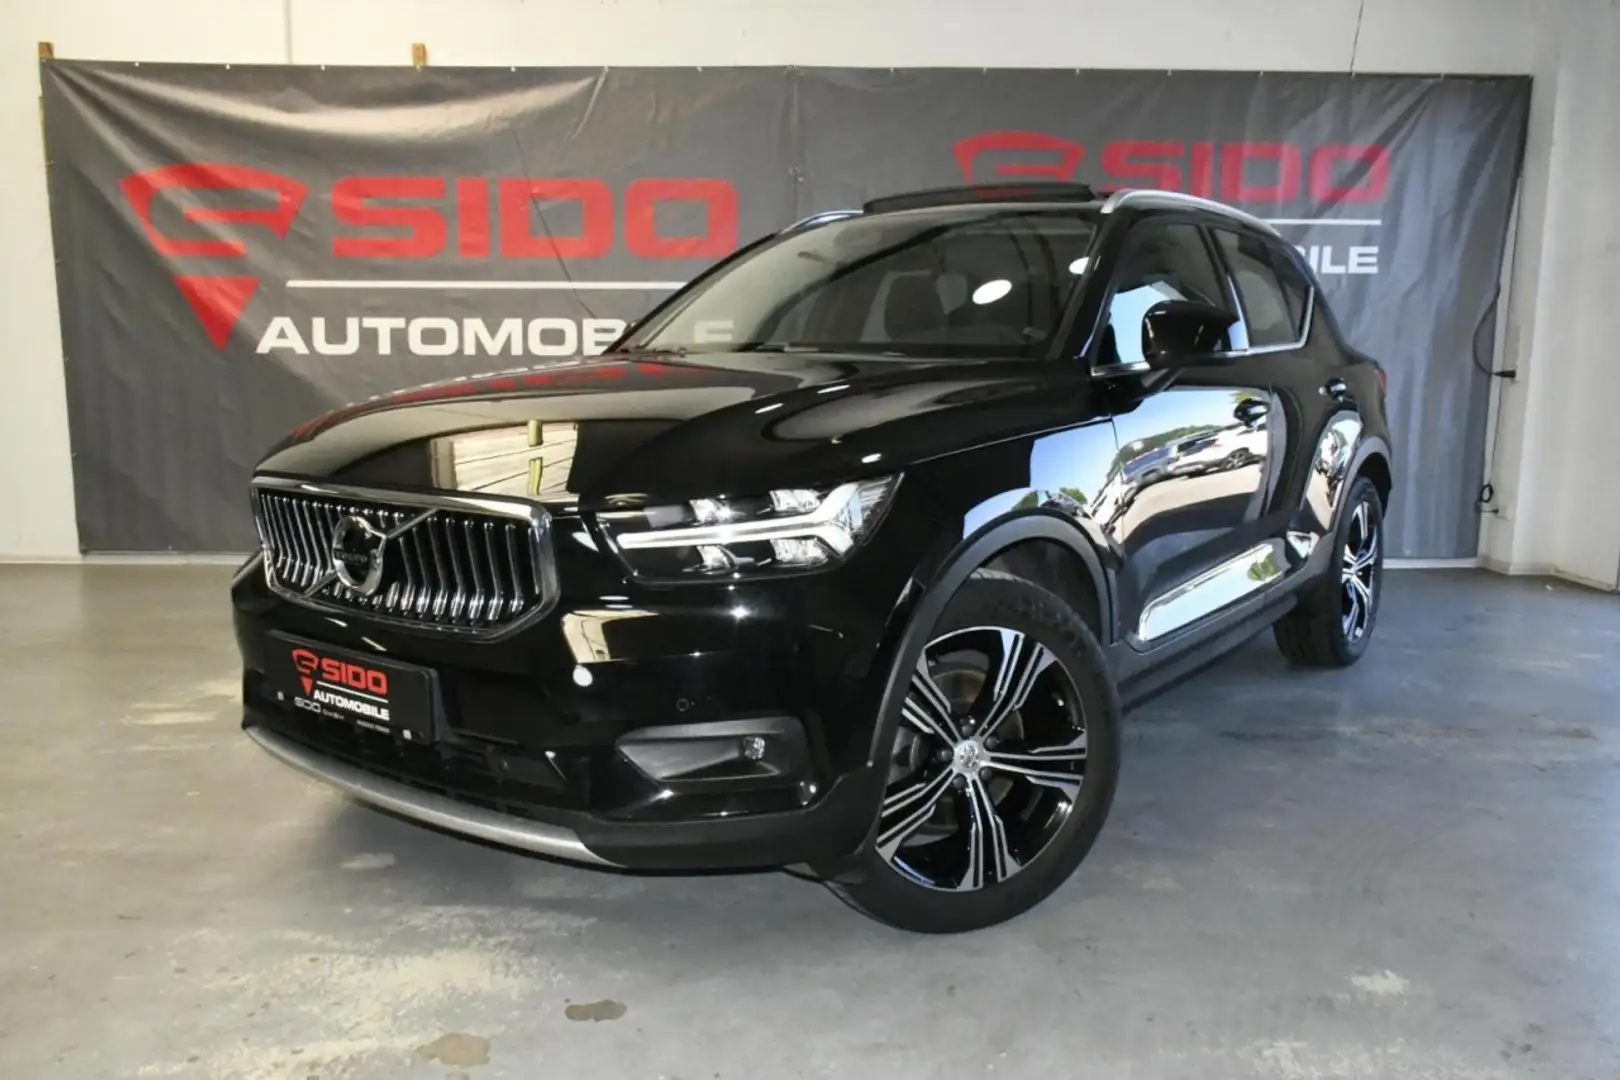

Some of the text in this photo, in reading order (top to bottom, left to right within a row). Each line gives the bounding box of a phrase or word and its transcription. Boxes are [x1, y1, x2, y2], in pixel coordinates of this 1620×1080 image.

[1101, 139, 1390, 206] SIDO
[330, 176, 740, 260] SIDO
[256, 316, 735, 357] AUTOMOBE
[321, 655, 388, 696] SIDO
[313, 689, 391, 721] AUTOMOBILE
